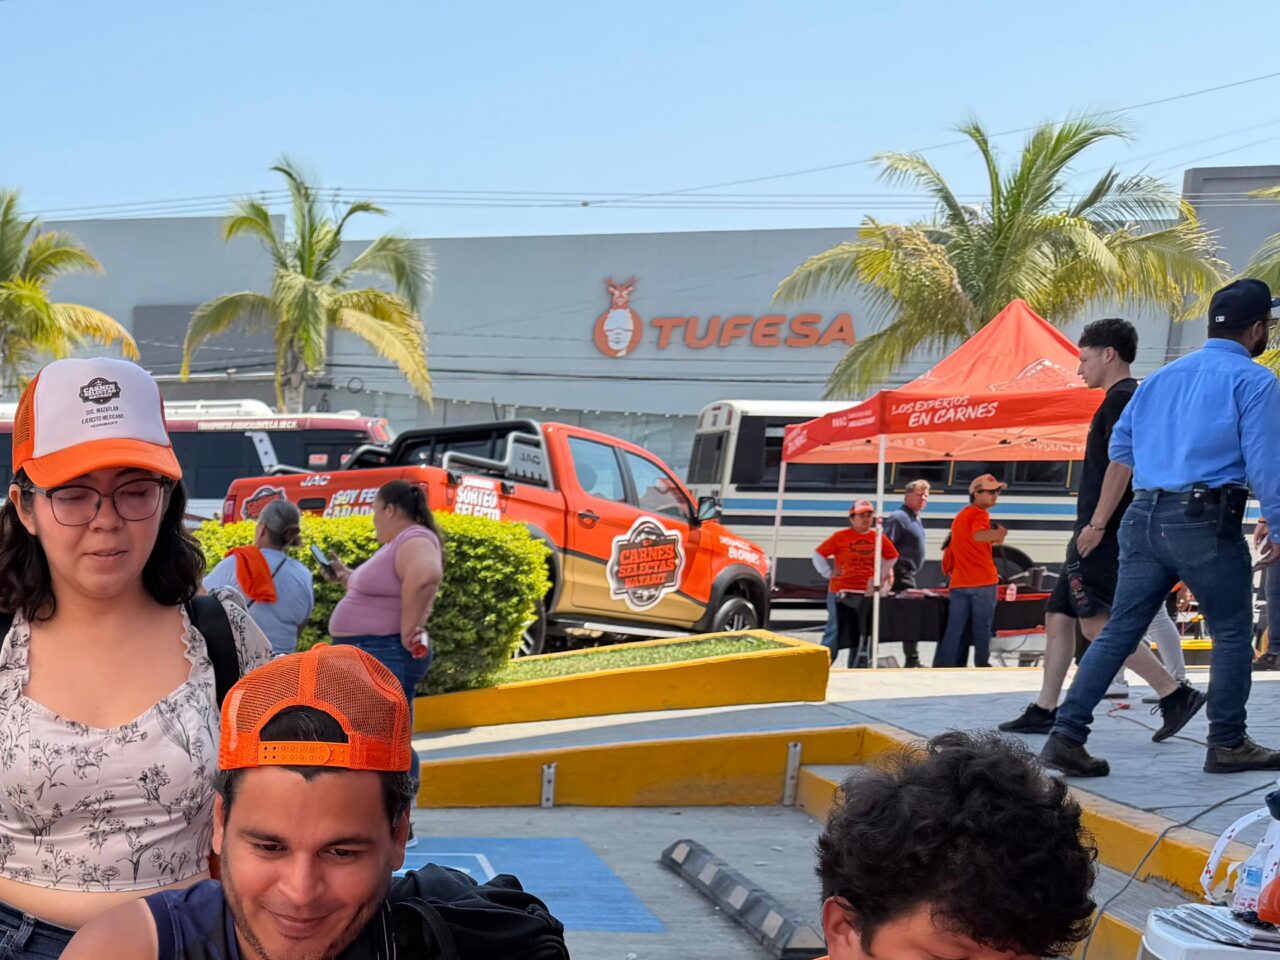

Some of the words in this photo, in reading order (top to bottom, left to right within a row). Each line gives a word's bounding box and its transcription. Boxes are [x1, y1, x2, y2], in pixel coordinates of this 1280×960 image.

[651, 312, 856, 349] TUFESA
[891, 402, 917, 415] LOS
[915, 395, 970, 409] EXPERTOS
[909, 412, 932, 428] EN
[933, 401, 999, 423] CARNES
[300, 474, 331, 487] JAC
[457, 487, 498, 509] SORTEO
[620, 544, 675, 565] CARNES
[618, 559, 675, 578] SELECTAS
